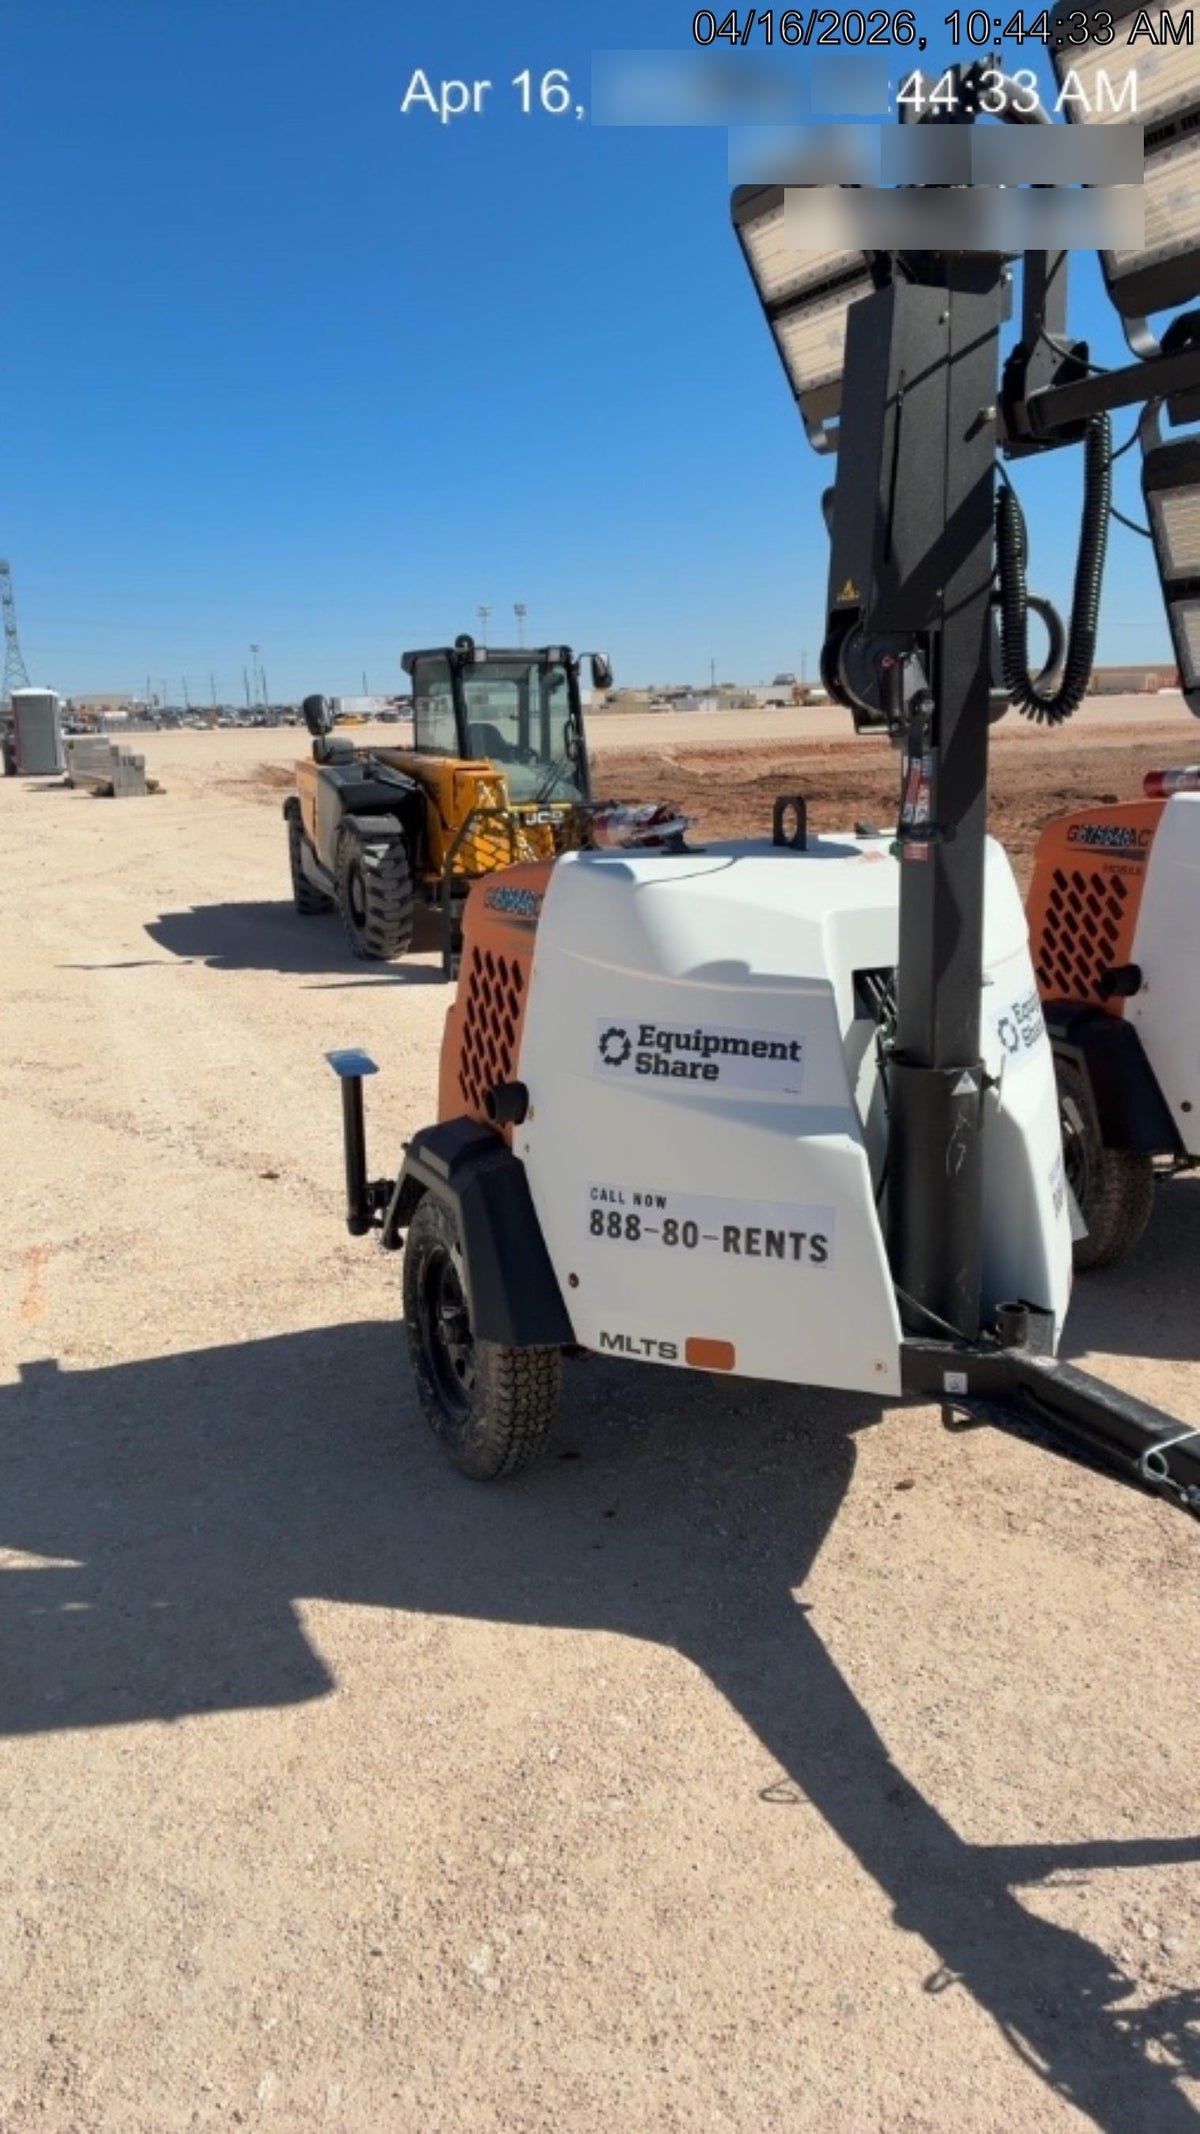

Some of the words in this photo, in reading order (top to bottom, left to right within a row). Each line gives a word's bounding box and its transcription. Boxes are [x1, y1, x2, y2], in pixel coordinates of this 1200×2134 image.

[637, 1024, 802, 1063] Equipment
[635, 1051, 720, 1081] Share
[589, 1187, 626, 1206] CALL
[633, 1193, 667, 1210] NOW
[589, 1208, 829, 1263] 888-80-RENTS
[599, 1331, 678, 1360] MLTS
